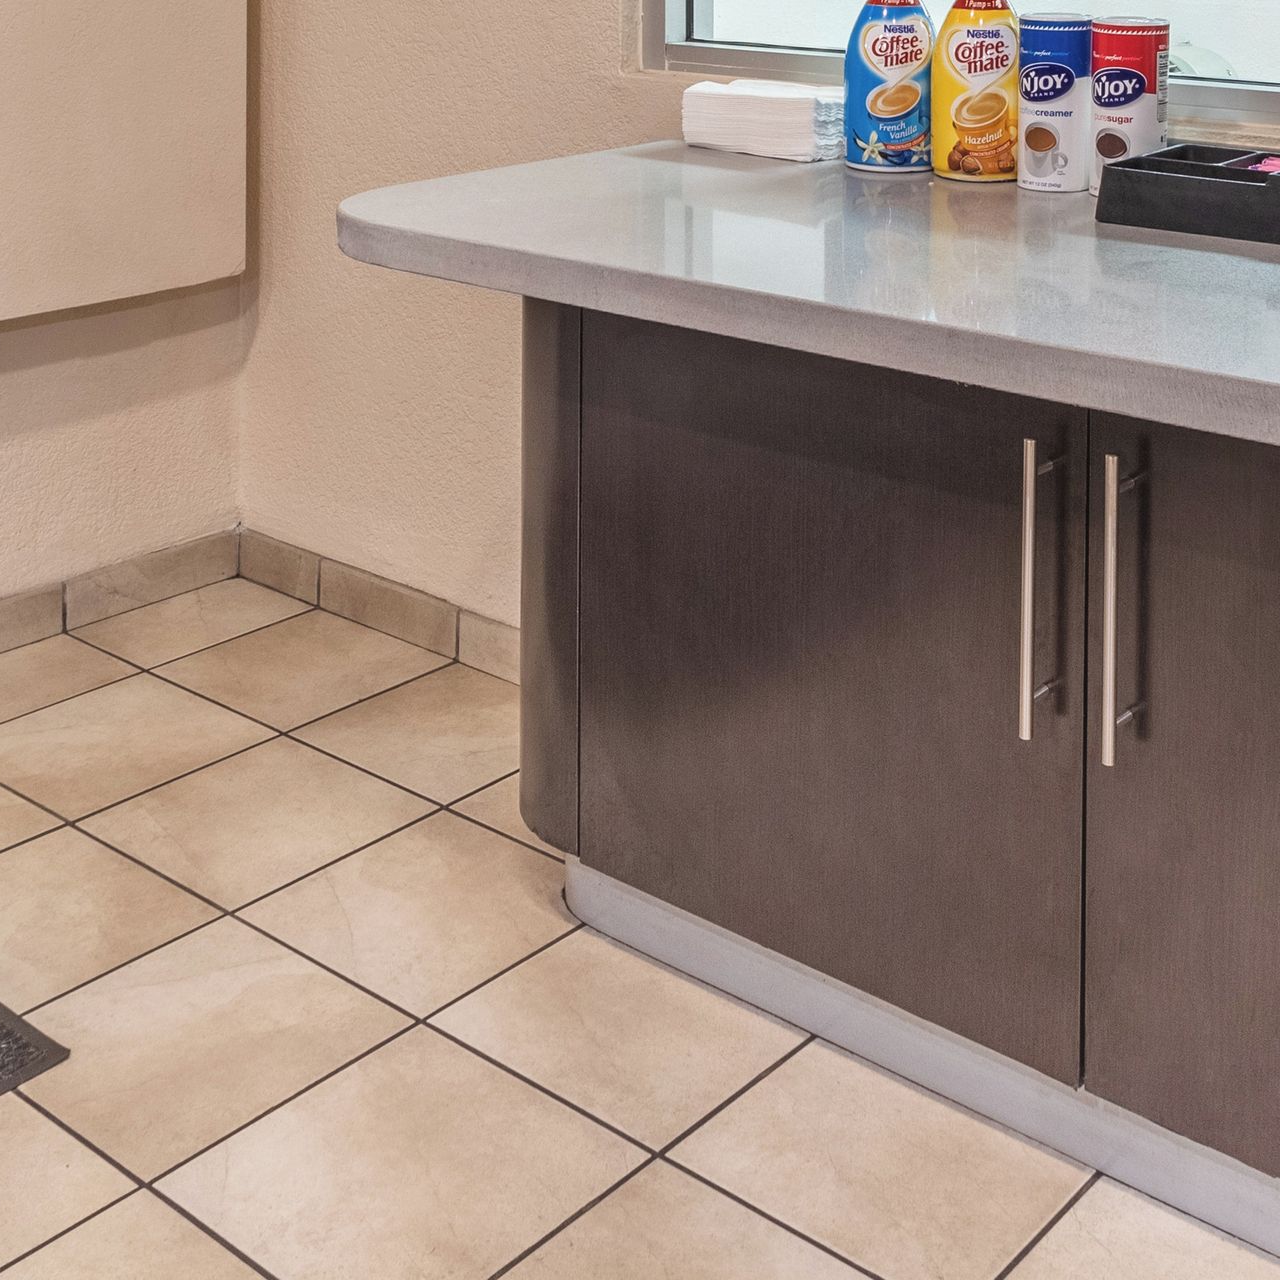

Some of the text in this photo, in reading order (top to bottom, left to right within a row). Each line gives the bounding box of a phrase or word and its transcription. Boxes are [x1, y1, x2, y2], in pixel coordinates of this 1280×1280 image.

[968, 0, 986, 9] Pump
[884, 48, 923, 68] mate
[967, 53, 1009, 74] mate
[879, 121, 905, 132] French
[890, 125, 918, 139] Vanilla
[964, 129, 1003, 145] Hazelnut
